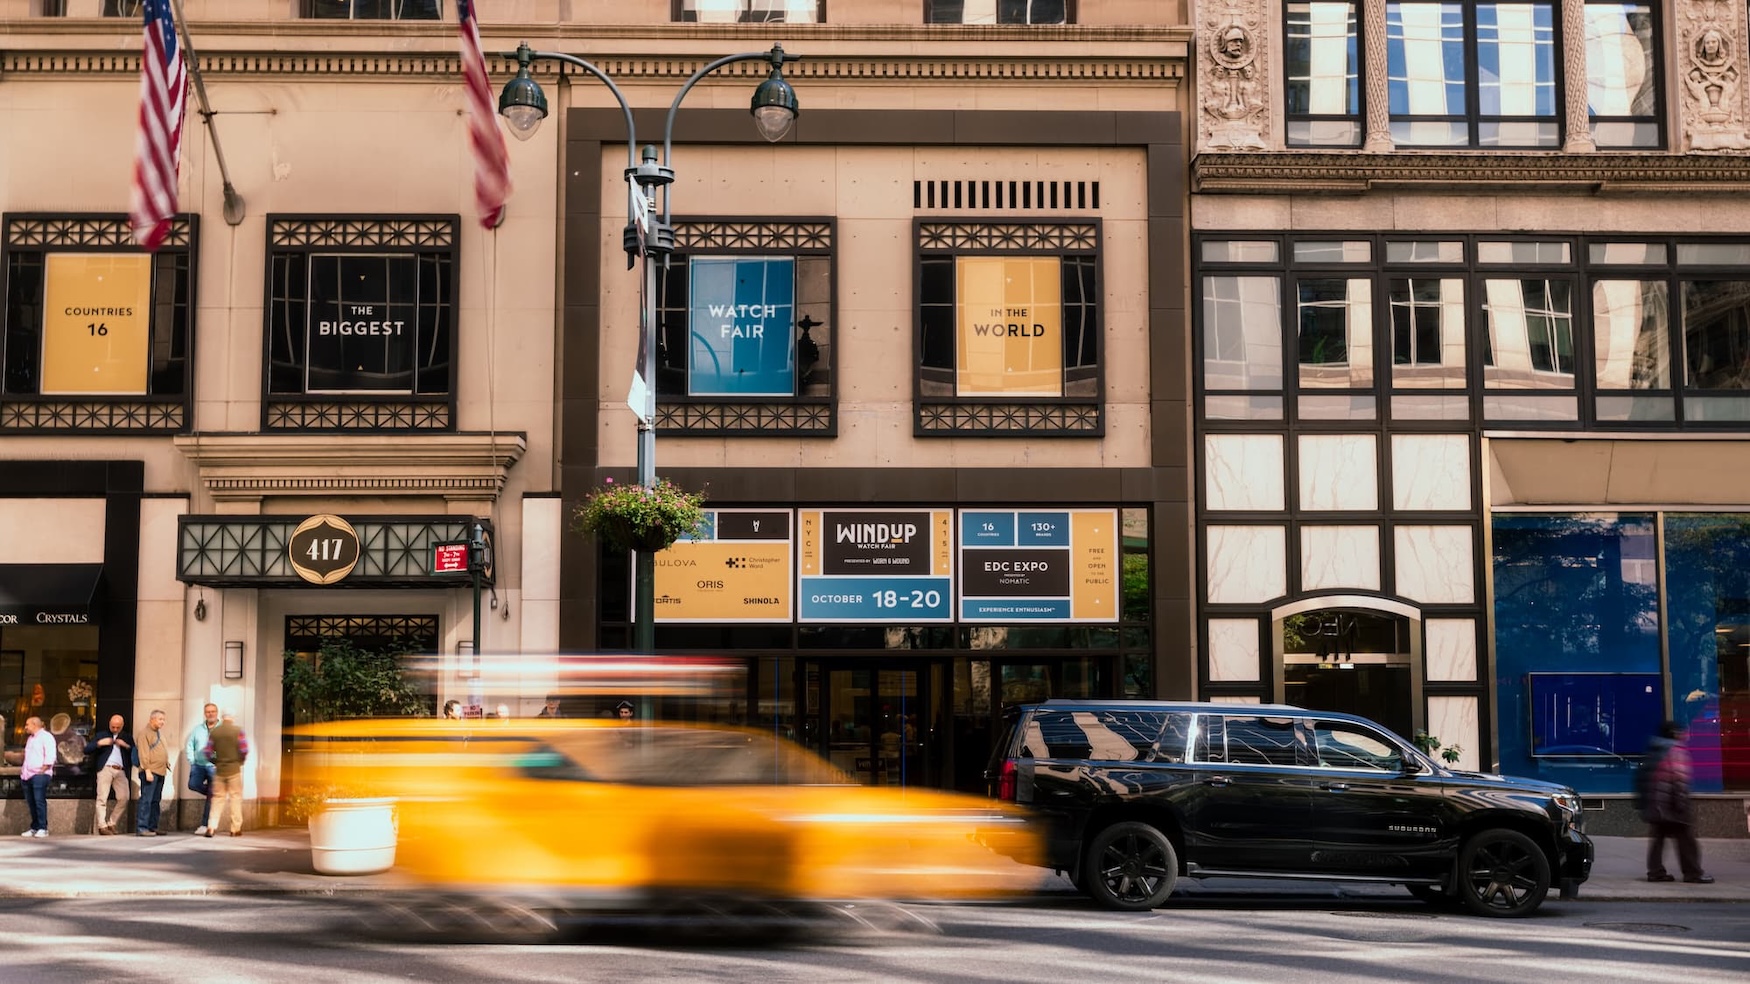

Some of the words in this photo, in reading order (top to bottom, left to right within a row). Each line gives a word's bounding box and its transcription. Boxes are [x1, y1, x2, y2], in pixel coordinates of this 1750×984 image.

[65, 307, 133, 316] COUNTRIES
[351, 306, 373, 316] THE
[708, 304, 776, 318] WATCH
[990, 308, 1002, 317] IN
[1005, 308, 1028, 317] THE
[87, 322, 108, 337] 16
[319, 321, 405, 336] BIGGEST
[721, 324, 764, 338] FAIR
[973, 323, 1045, 337] WORLD
[836, 523, 917, 544] WINDUP
[982, 523, 994, 531] 16
[1031, 523, 1056, 531] 130+
[305, 538, 343, 561] 417
[984, 561, 1010, 571] EDC
[1013, 561, 1048, 571] EXPO
[697, 580, 724, 589] ORIS
[811, 595, 863, 603] OCTOBER
[872, 590, 941, 608] 18-20
[36, 611, 88, 624] CRYSTALS
[1388, 824, 1437, 833] SUBURBAN
